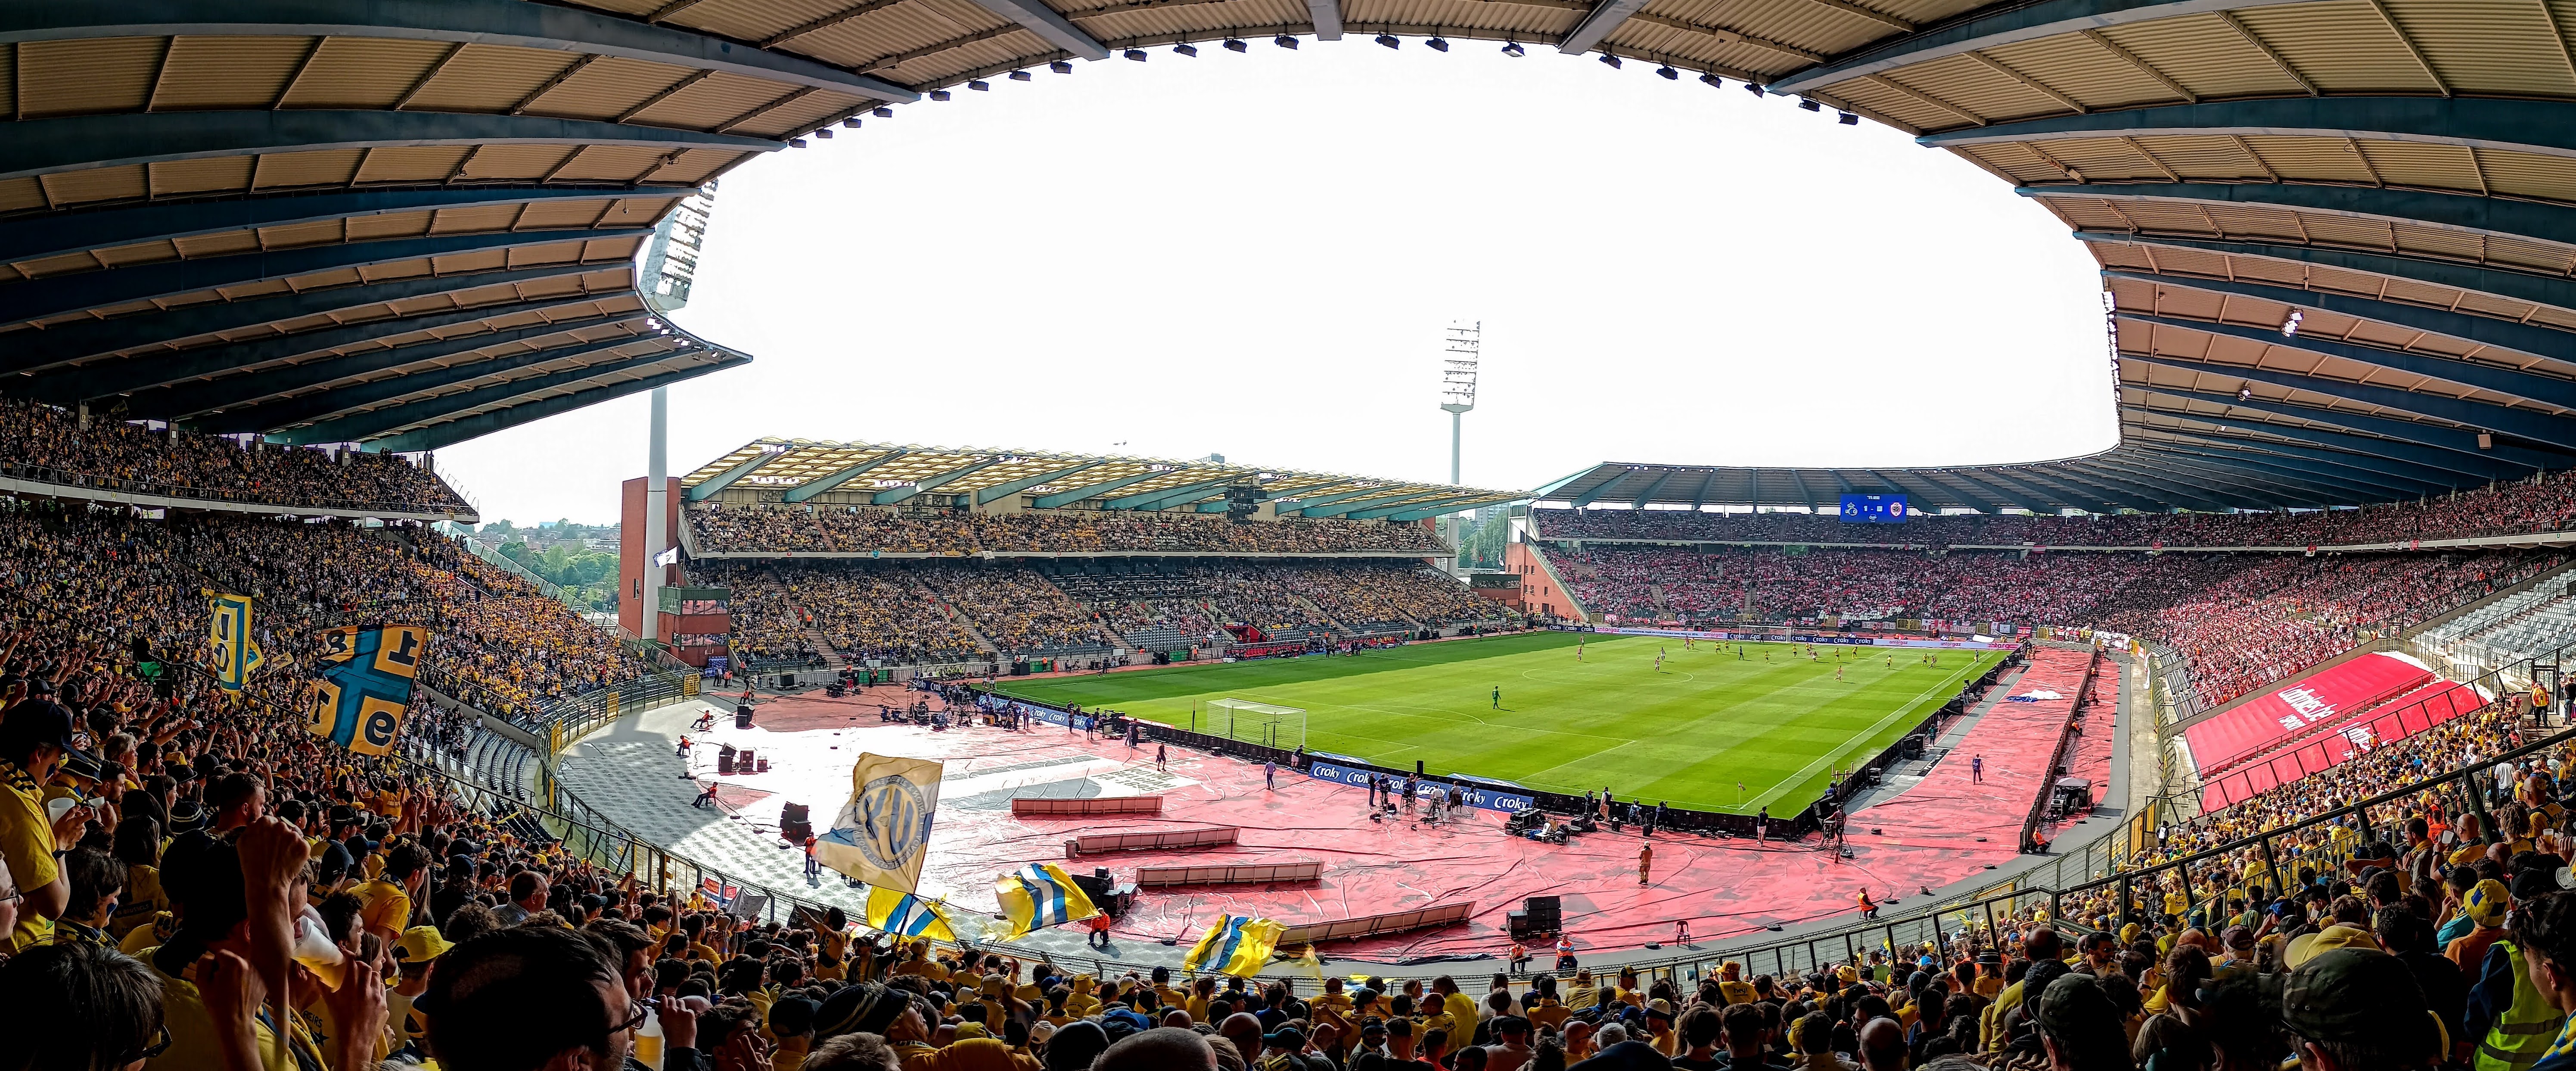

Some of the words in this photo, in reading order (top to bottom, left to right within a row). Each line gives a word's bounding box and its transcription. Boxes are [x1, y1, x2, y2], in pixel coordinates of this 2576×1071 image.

[930, 682, 941, 691] Crok
[1048, 713, 1066, 723] Croky
[1074, 717, 1086, 727] roky
[1130, 768, 1178, 781] ROYAL
[1314, 766, 1340, 779] Croky
[1346, 771, 1370, 784] Crok
[1108, 771, 1176, 788] BELGIAN
[1389, 779, 1404, 790] rok
[1416, 783, 1447, 797] Croy
[1460, 789, 1486, 804] roky
[1494, 796, 1527, 809] Croky
